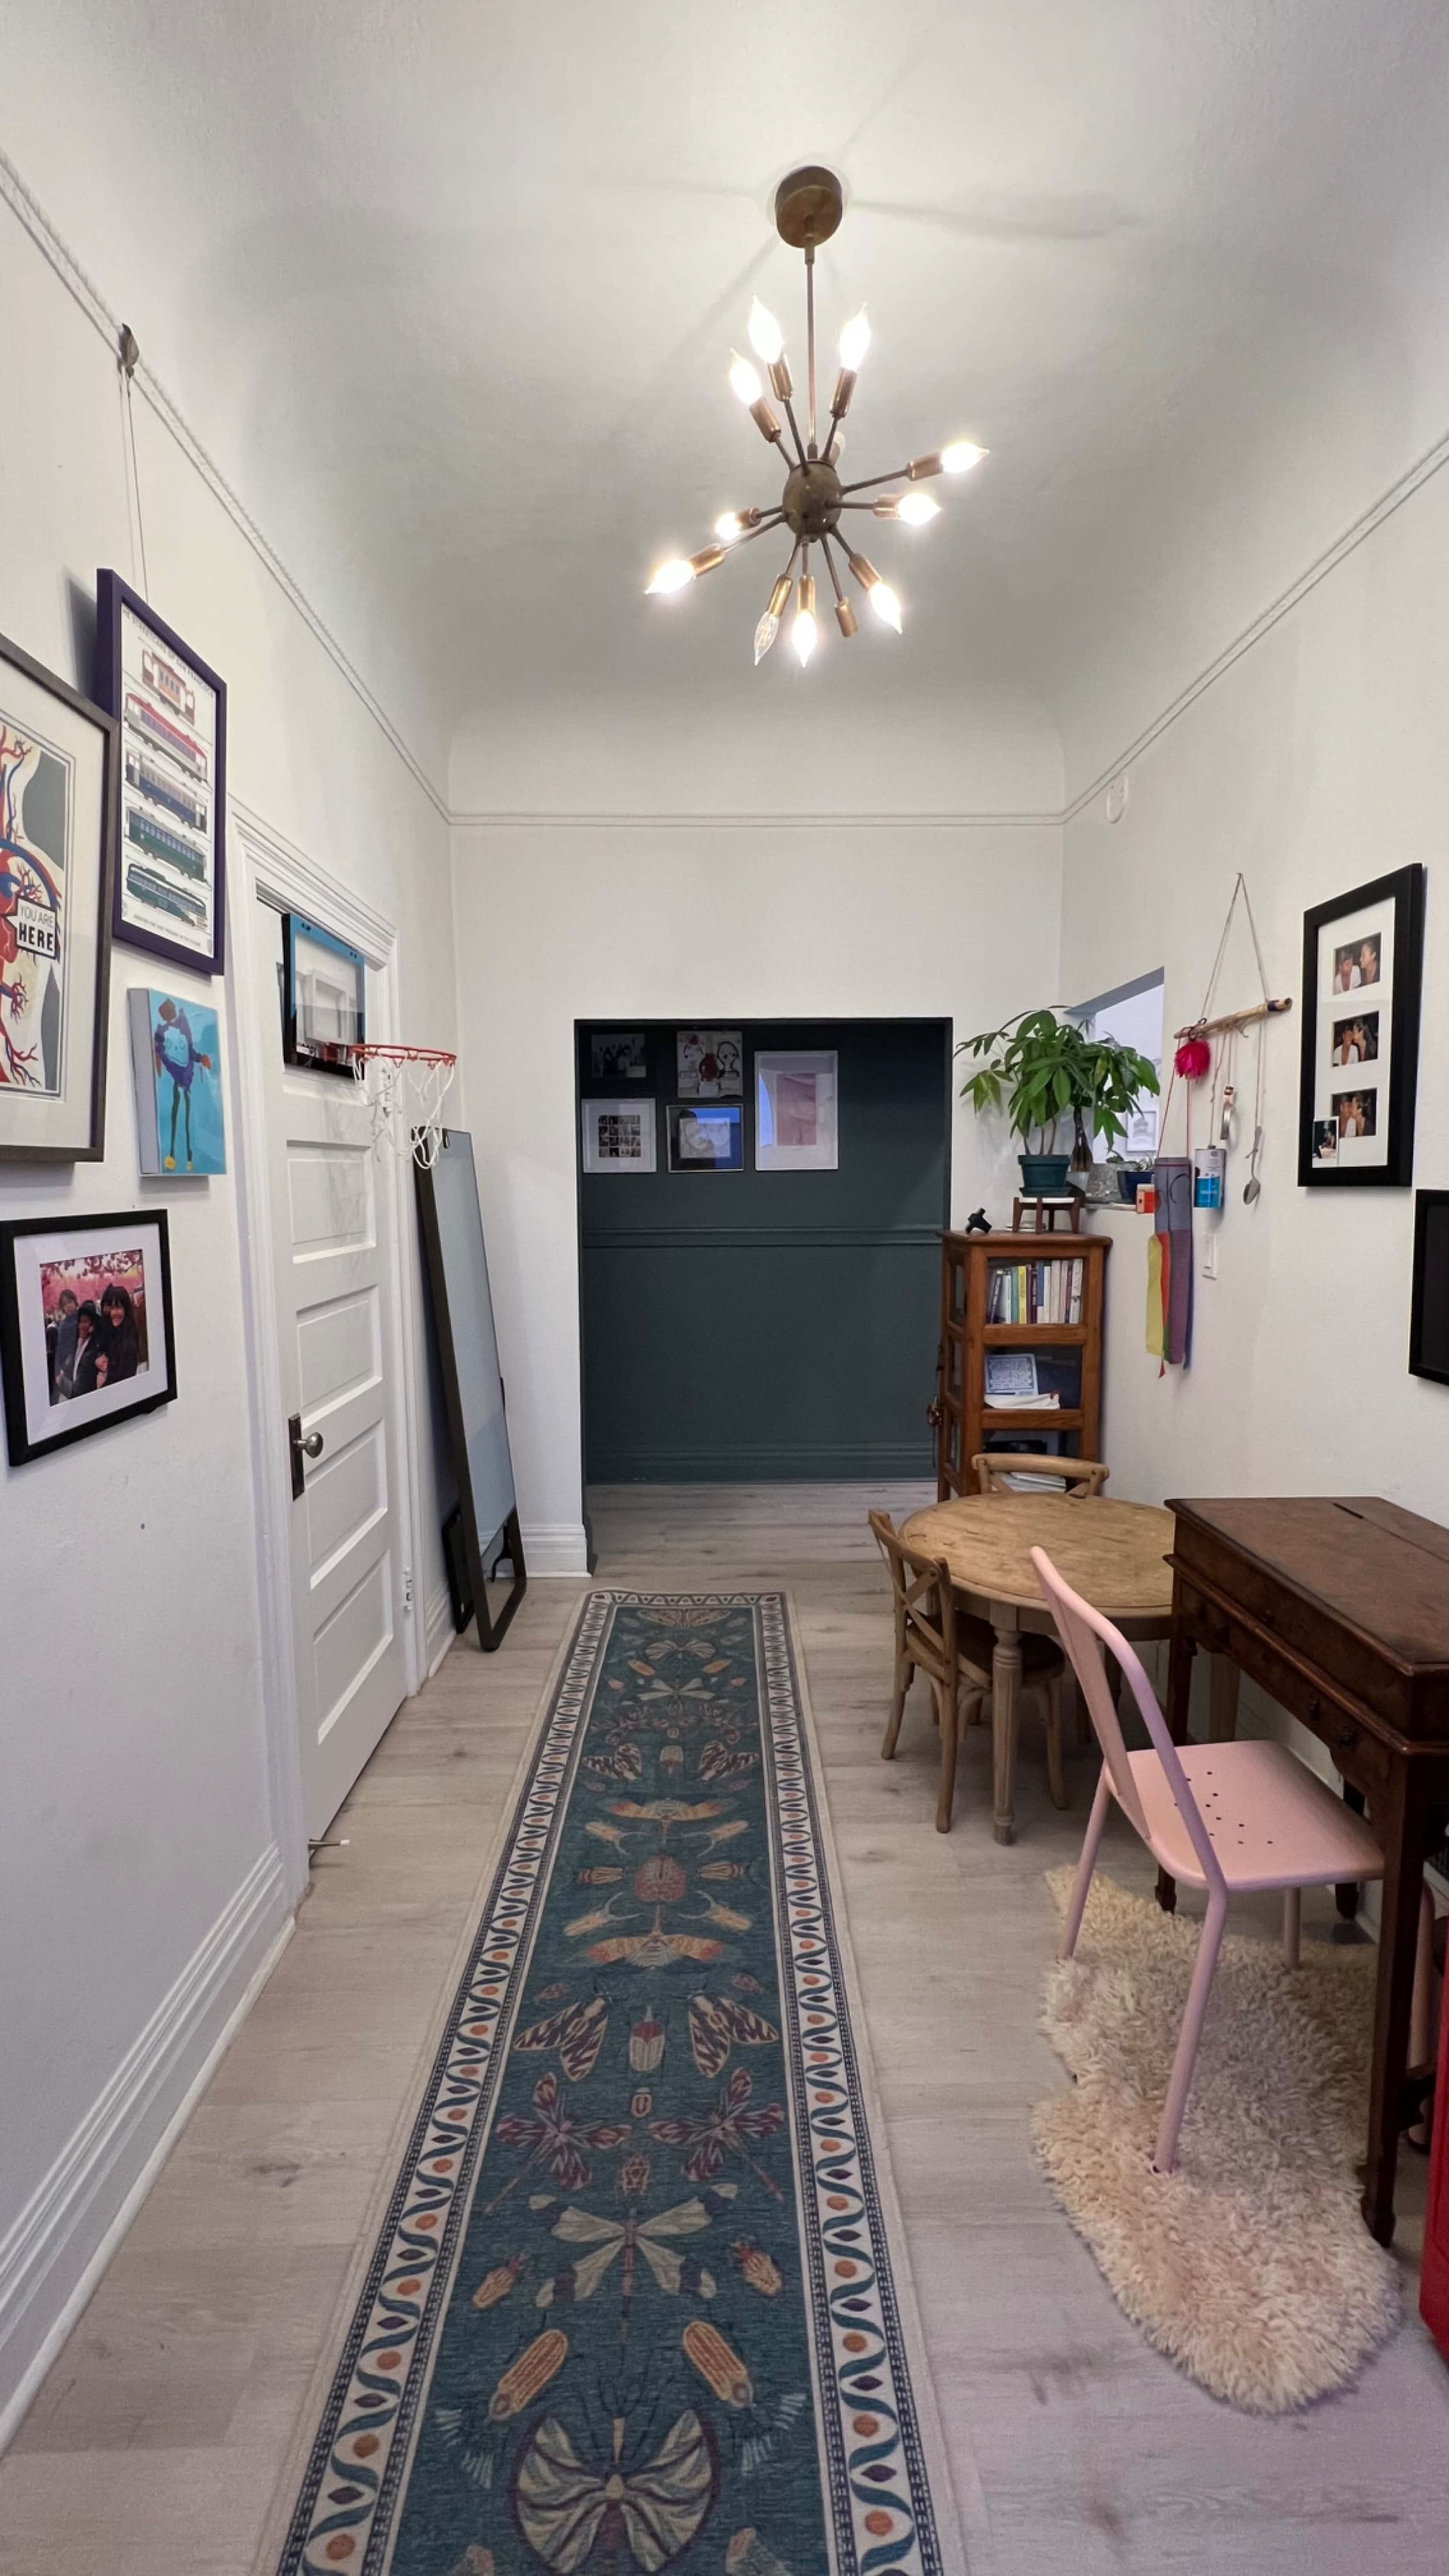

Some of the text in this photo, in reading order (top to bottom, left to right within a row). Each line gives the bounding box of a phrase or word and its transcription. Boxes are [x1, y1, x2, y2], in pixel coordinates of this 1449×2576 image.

[20, 905, 54, 928] YOU ARE
[19, 922, 53, 951] HERE
